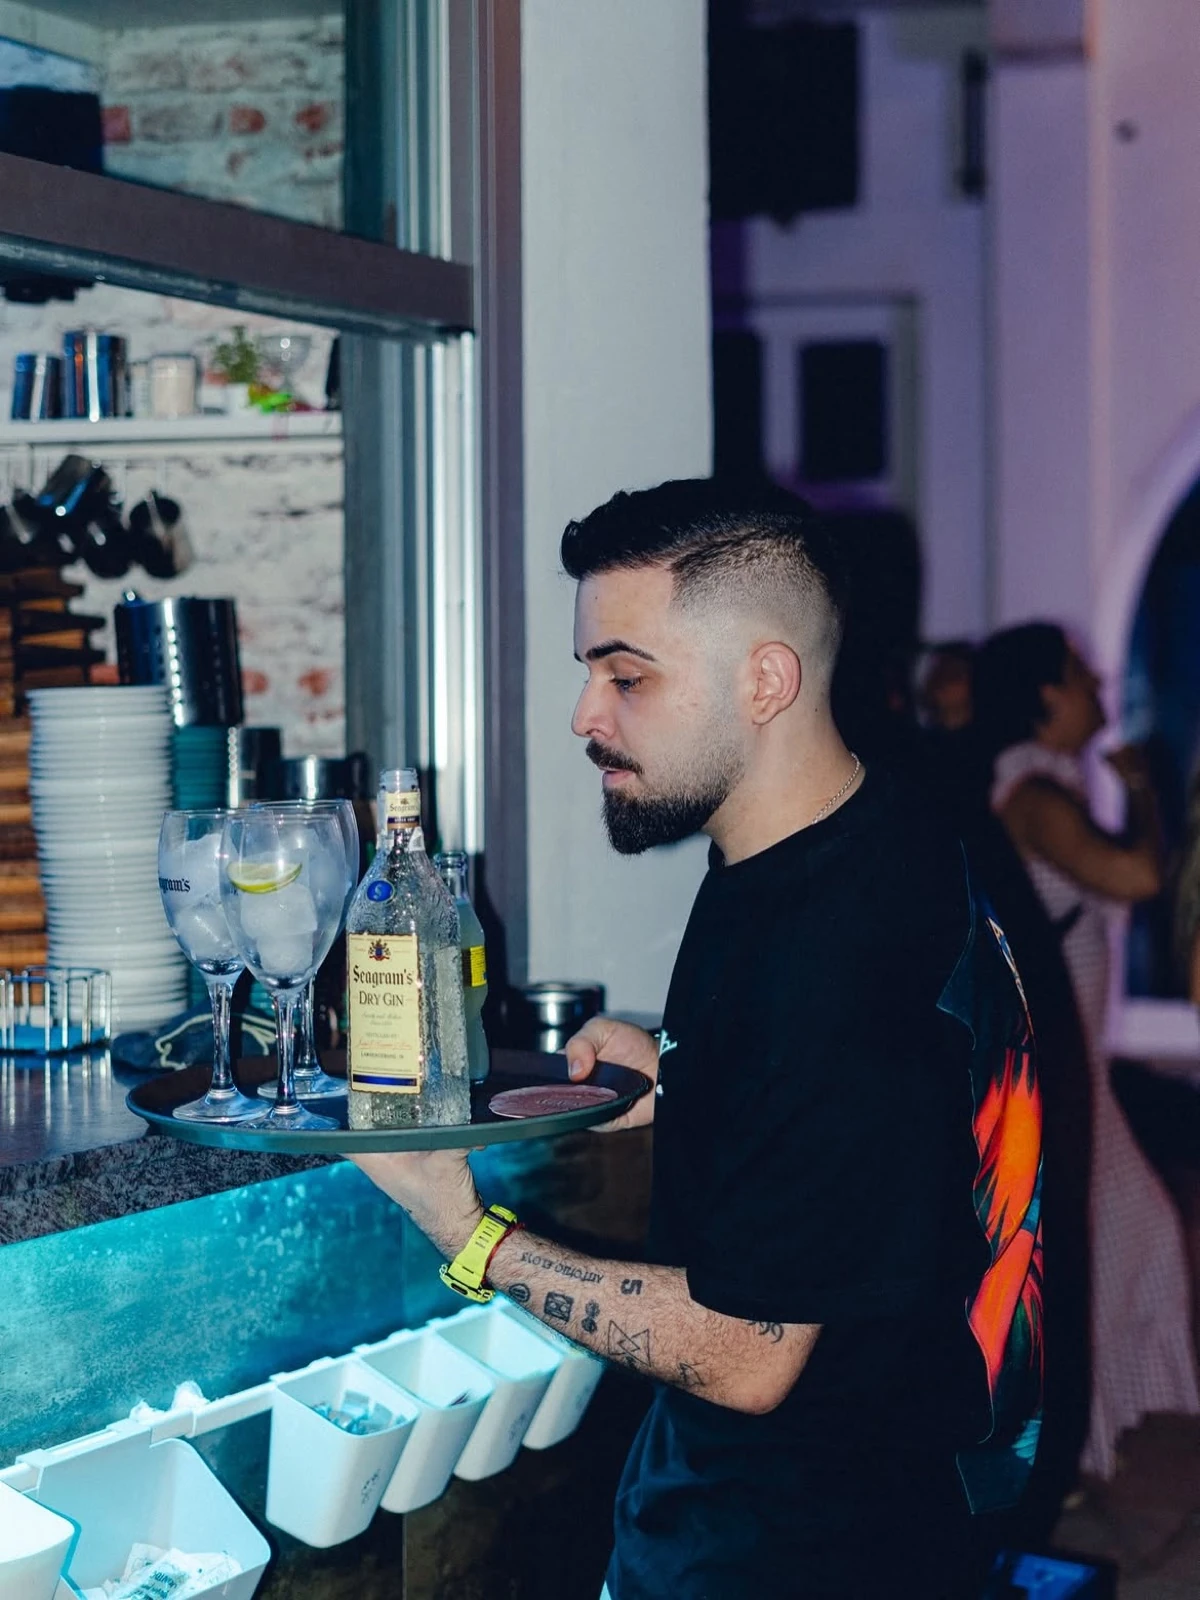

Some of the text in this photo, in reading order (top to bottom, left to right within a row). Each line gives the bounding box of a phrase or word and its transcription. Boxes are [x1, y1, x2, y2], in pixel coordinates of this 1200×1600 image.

[353, 965, 414, 988] Seagram's
[359, 991, 404, 1007] DRY GIN
